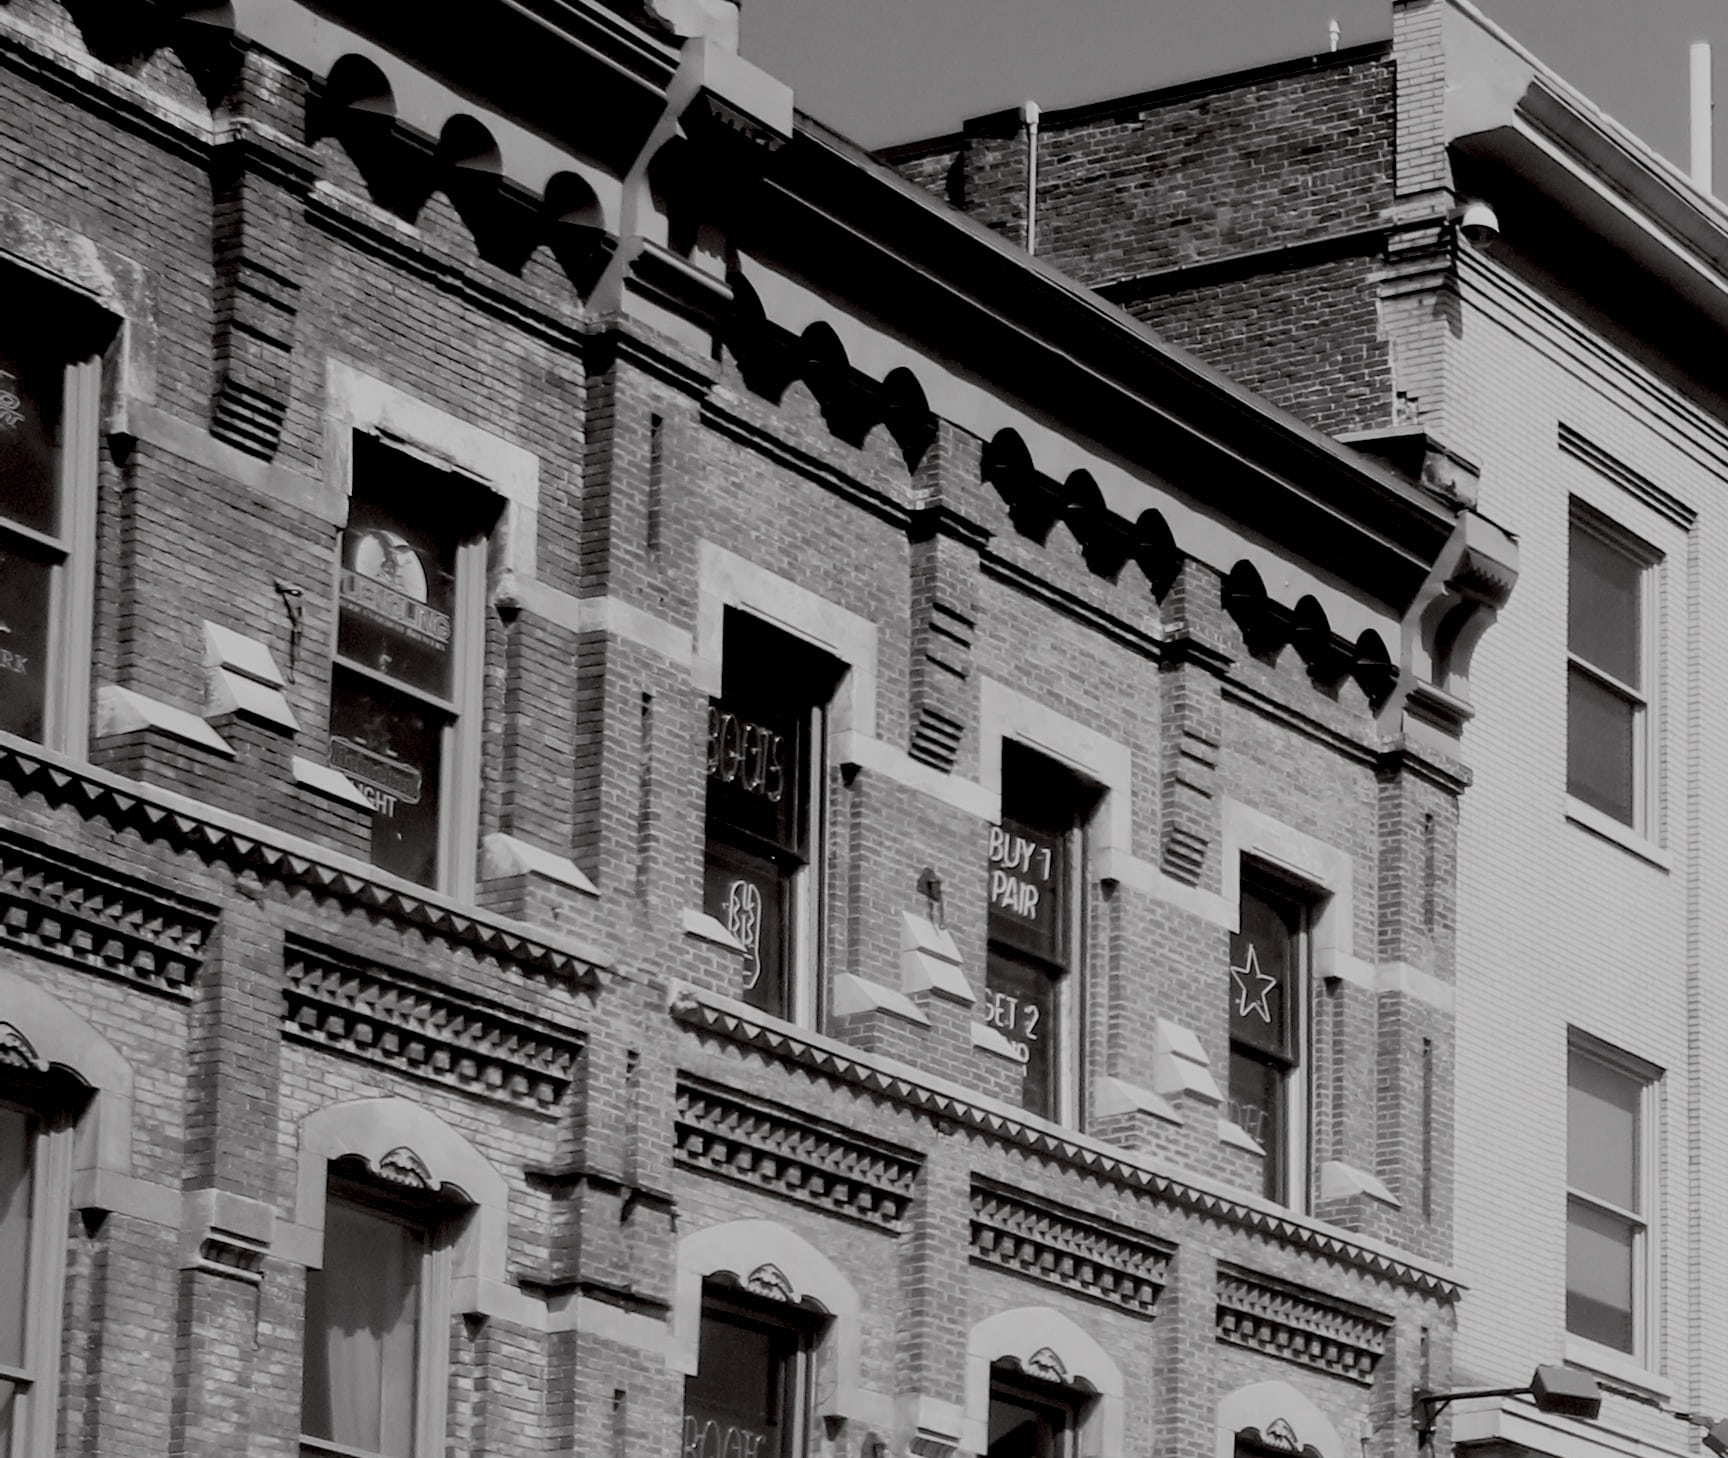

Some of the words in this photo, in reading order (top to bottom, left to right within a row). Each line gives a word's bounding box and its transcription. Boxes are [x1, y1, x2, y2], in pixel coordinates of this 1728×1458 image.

[707, 706, 784, 802] BOOTS
[990, 826, 1036, 873] BUY
[1037, 848, 1051, 881] 1
[991, 870, 1039, 920] PAIR
[1024, 1005, 1040, 1040] 2
